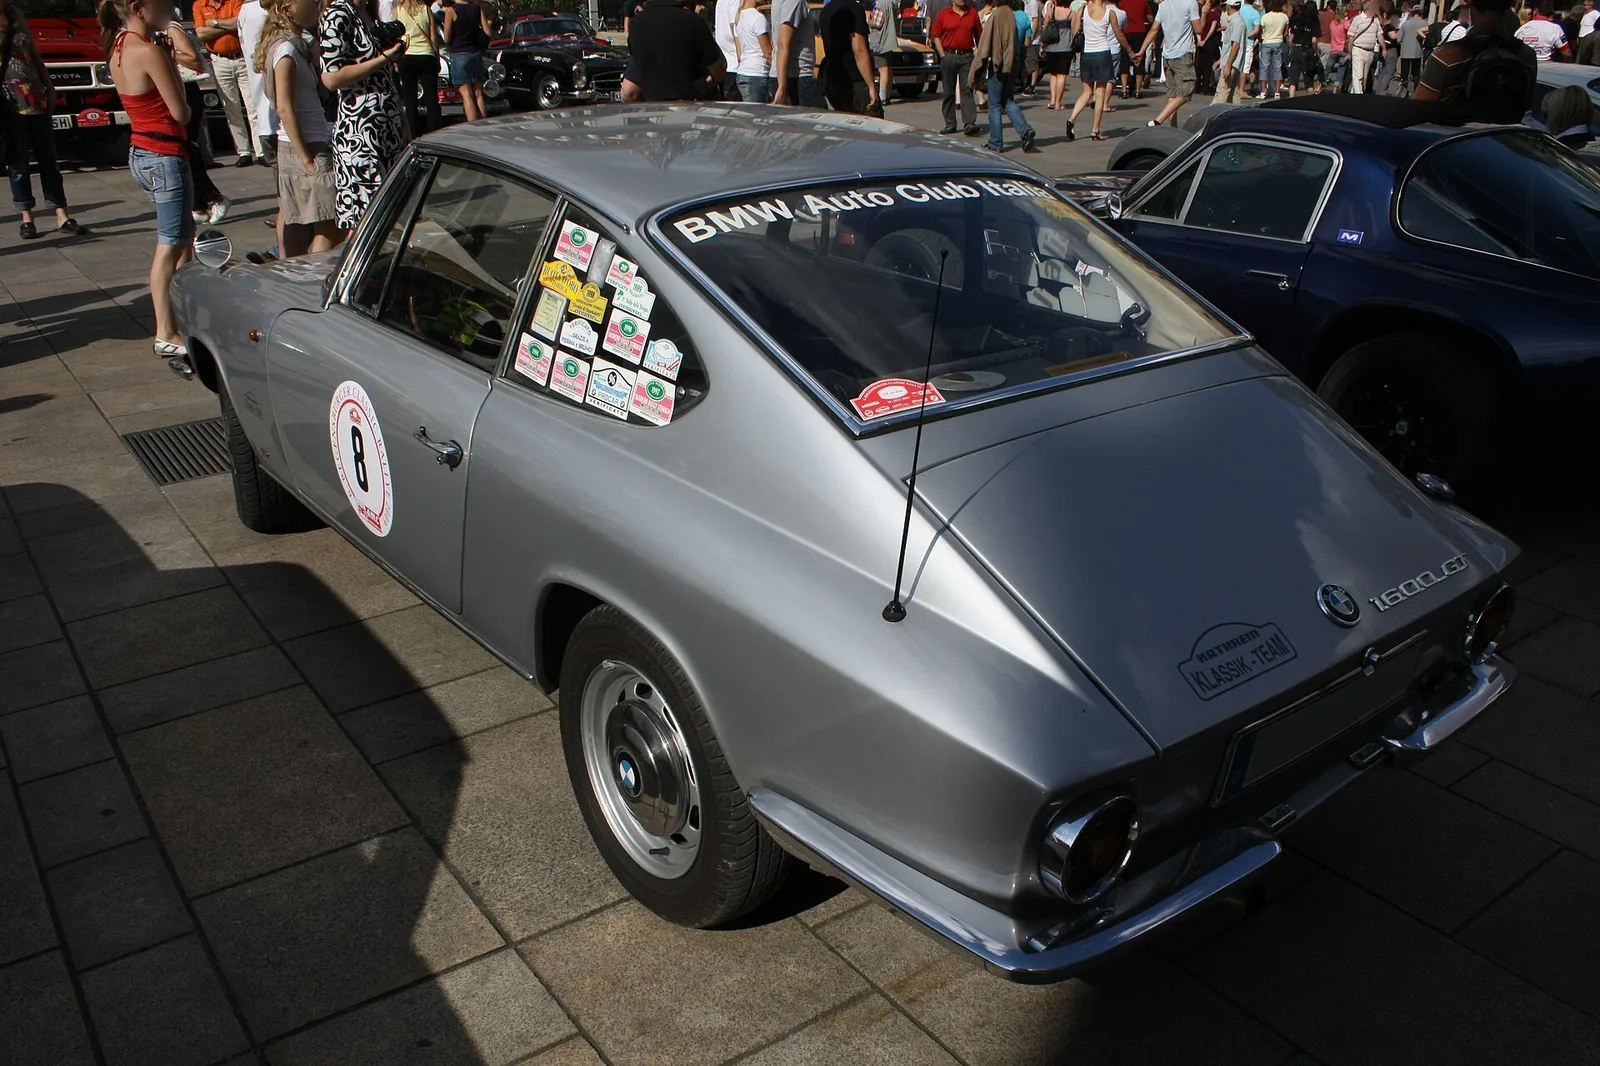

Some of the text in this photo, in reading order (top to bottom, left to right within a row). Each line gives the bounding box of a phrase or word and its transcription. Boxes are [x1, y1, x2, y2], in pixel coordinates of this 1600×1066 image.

[673, 179, 1056, 244] BMW Auto Club Italia
[1340, 232, 1359, 241] M
[607, 277, 629, 292] VERIFICATO
[569, 319, 592, 336] VERIFICATO
[644, 363, 677, 380] VERIFICATO
[352, 386, 378, 434] CLASSIC
[589, 398, 624, 416] VERIFICATO
[351, 425, 369, 492] 8
